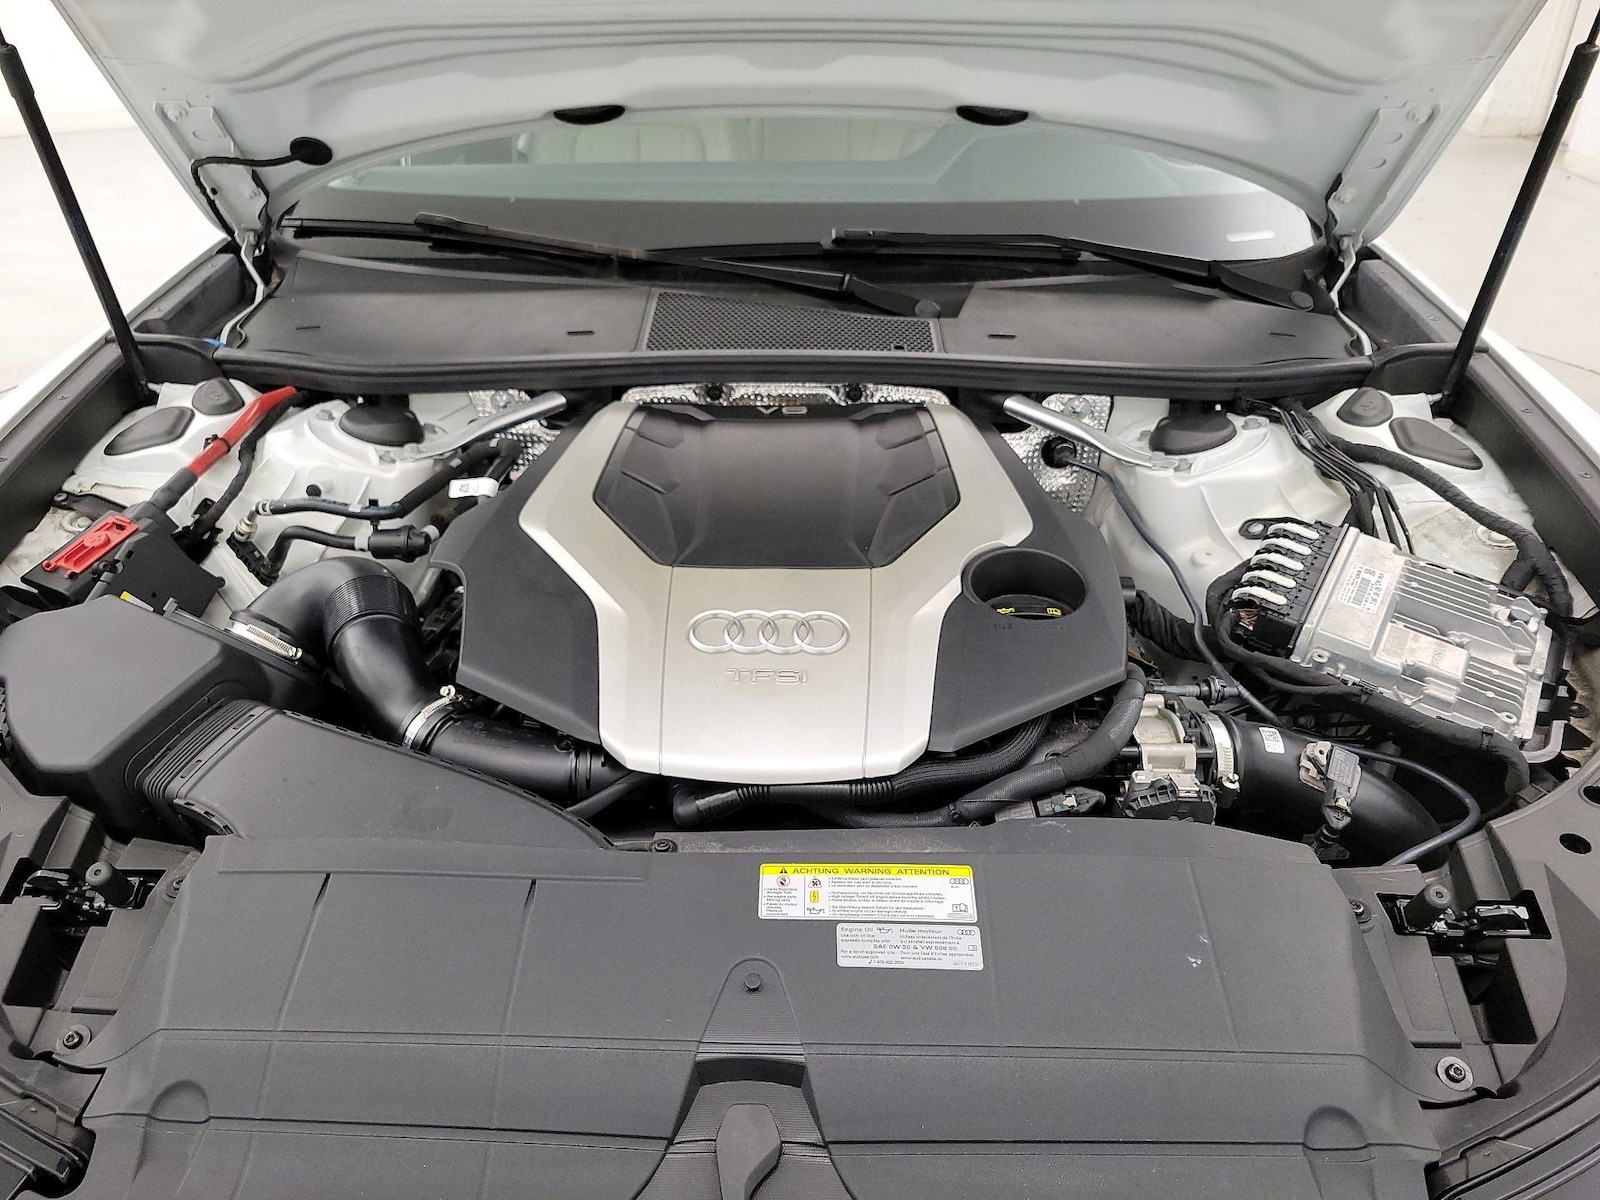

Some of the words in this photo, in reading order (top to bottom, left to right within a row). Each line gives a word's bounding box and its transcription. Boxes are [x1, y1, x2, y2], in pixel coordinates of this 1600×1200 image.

[724, 667, 808, 685] TFSI
[792, 867, 839, 875] ACHTUNG
[844, 867, 892, 876] WARNING
[896, 868, 950, 876] ATTENTION
